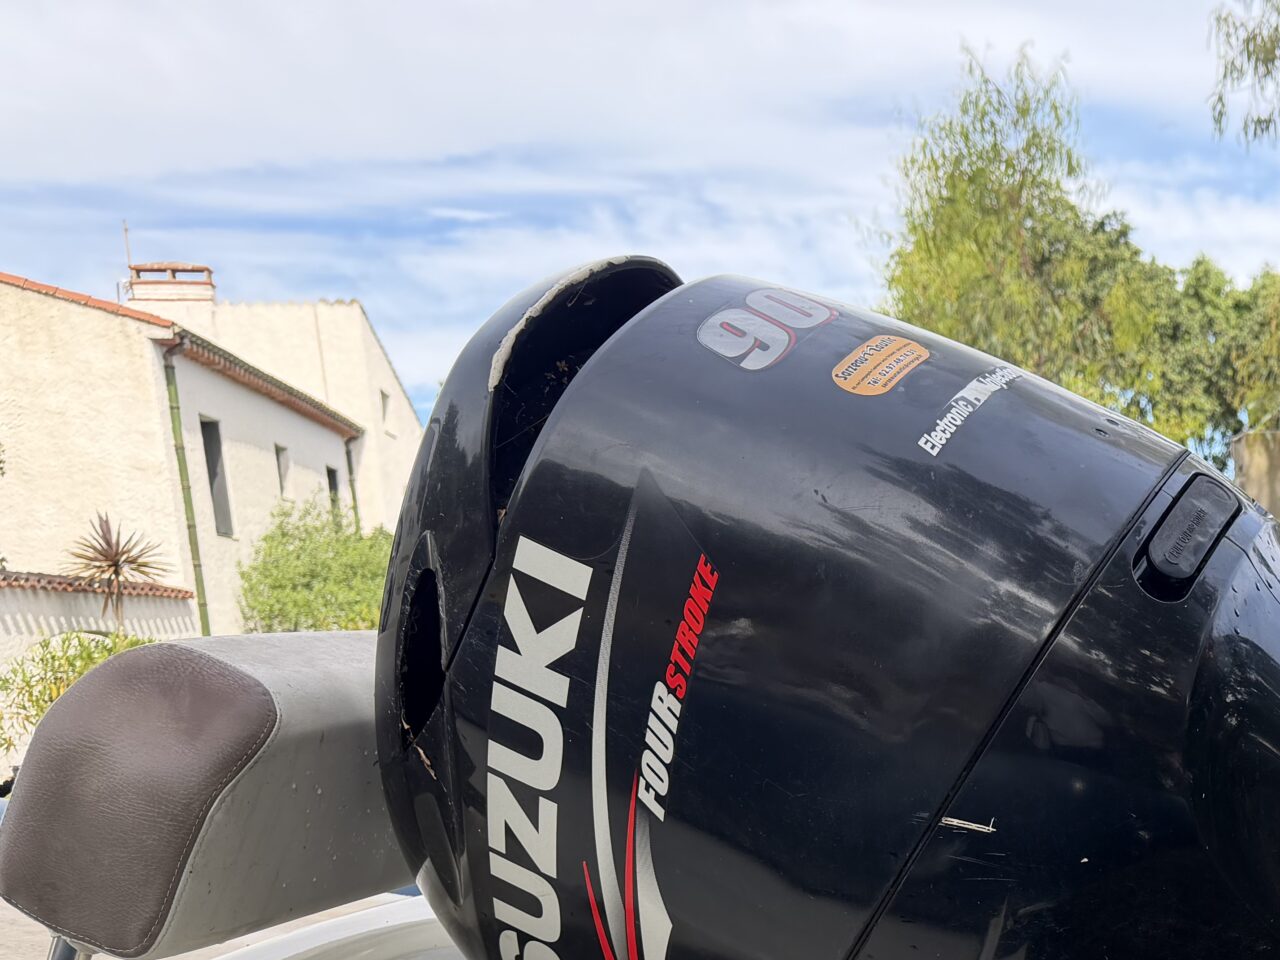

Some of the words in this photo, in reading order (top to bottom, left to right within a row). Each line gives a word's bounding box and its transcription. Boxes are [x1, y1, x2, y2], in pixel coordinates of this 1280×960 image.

[698, 287, 837, 370] 90
[918, 400, 974, 456] Electronic
[637, 680, 682, 822] FOUR
[665, 553, 719, 699] STROKE
